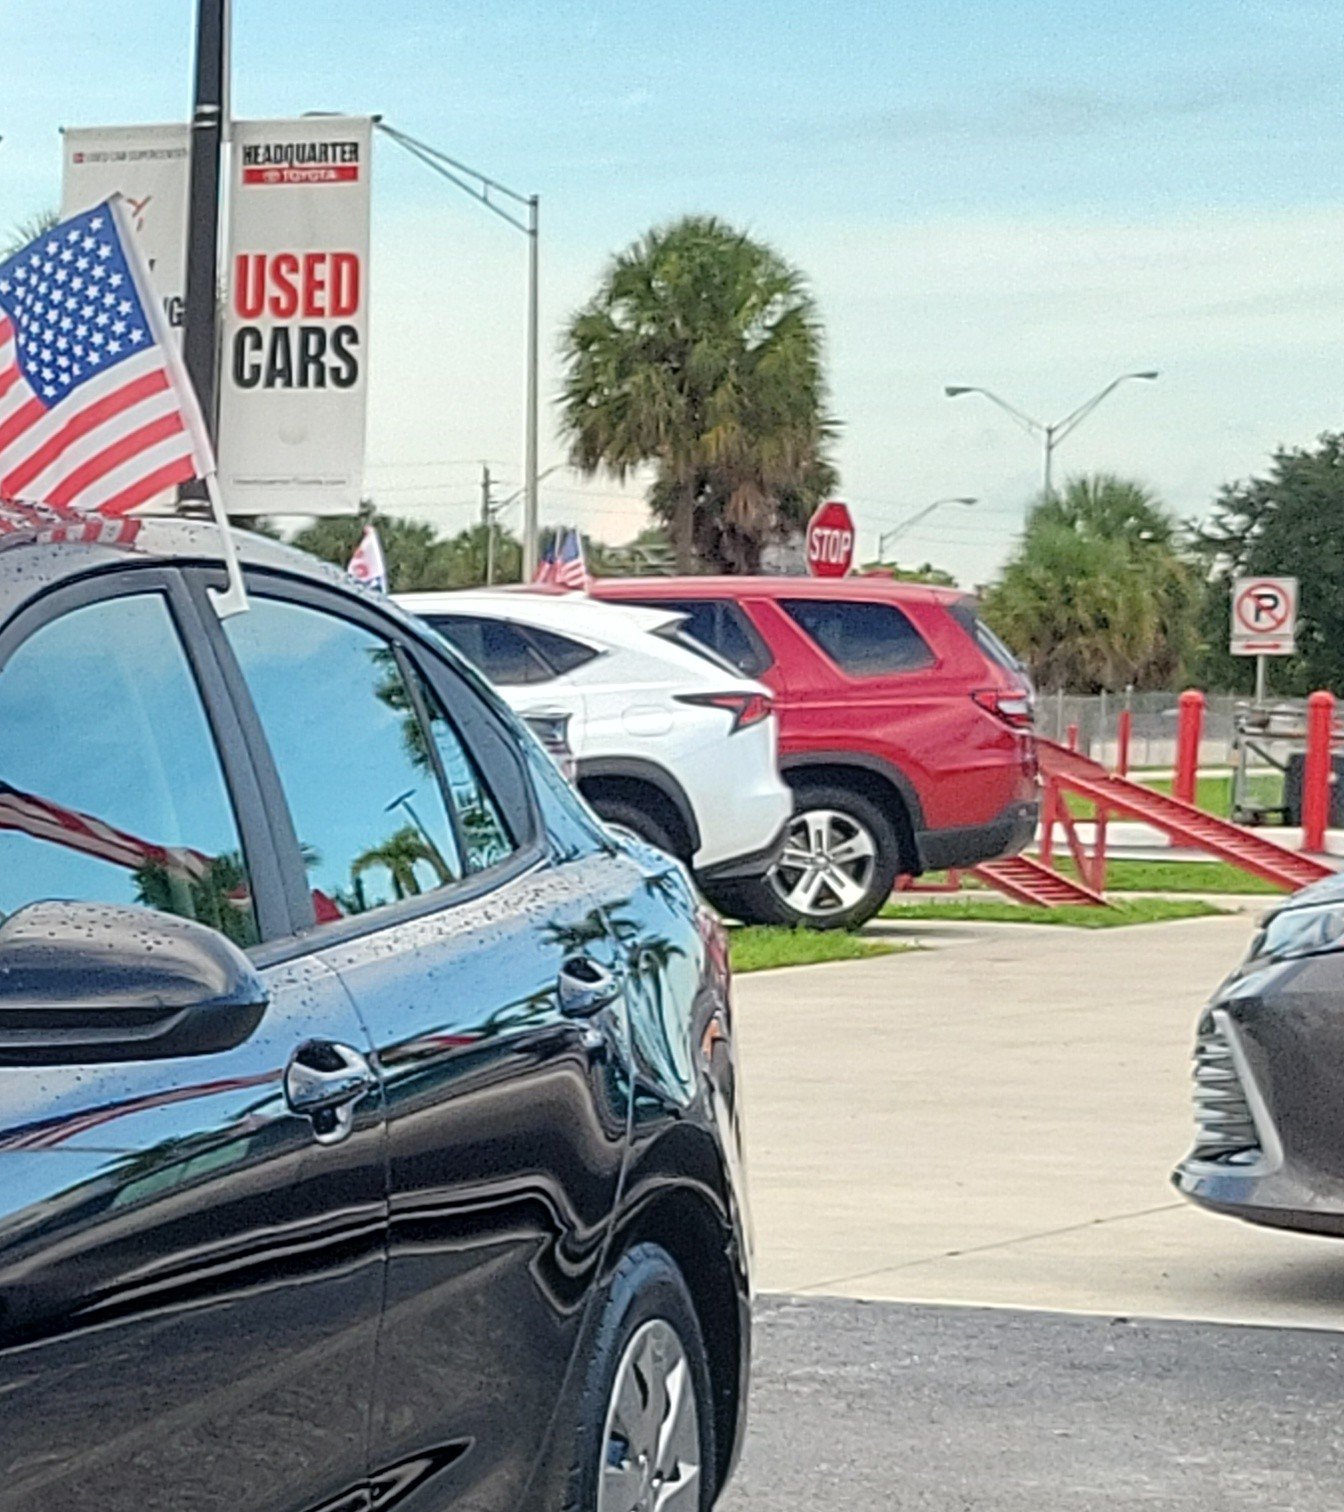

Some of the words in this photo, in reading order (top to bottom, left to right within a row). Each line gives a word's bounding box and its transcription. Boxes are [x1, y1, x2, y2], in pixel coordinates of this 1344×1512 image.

[242, 141, 359, 167] HEADQUARTER
[235, 252, 360, 319] USED
[232, 324, 360, 389] CARS
[810, 528, 852, 564] STOP
